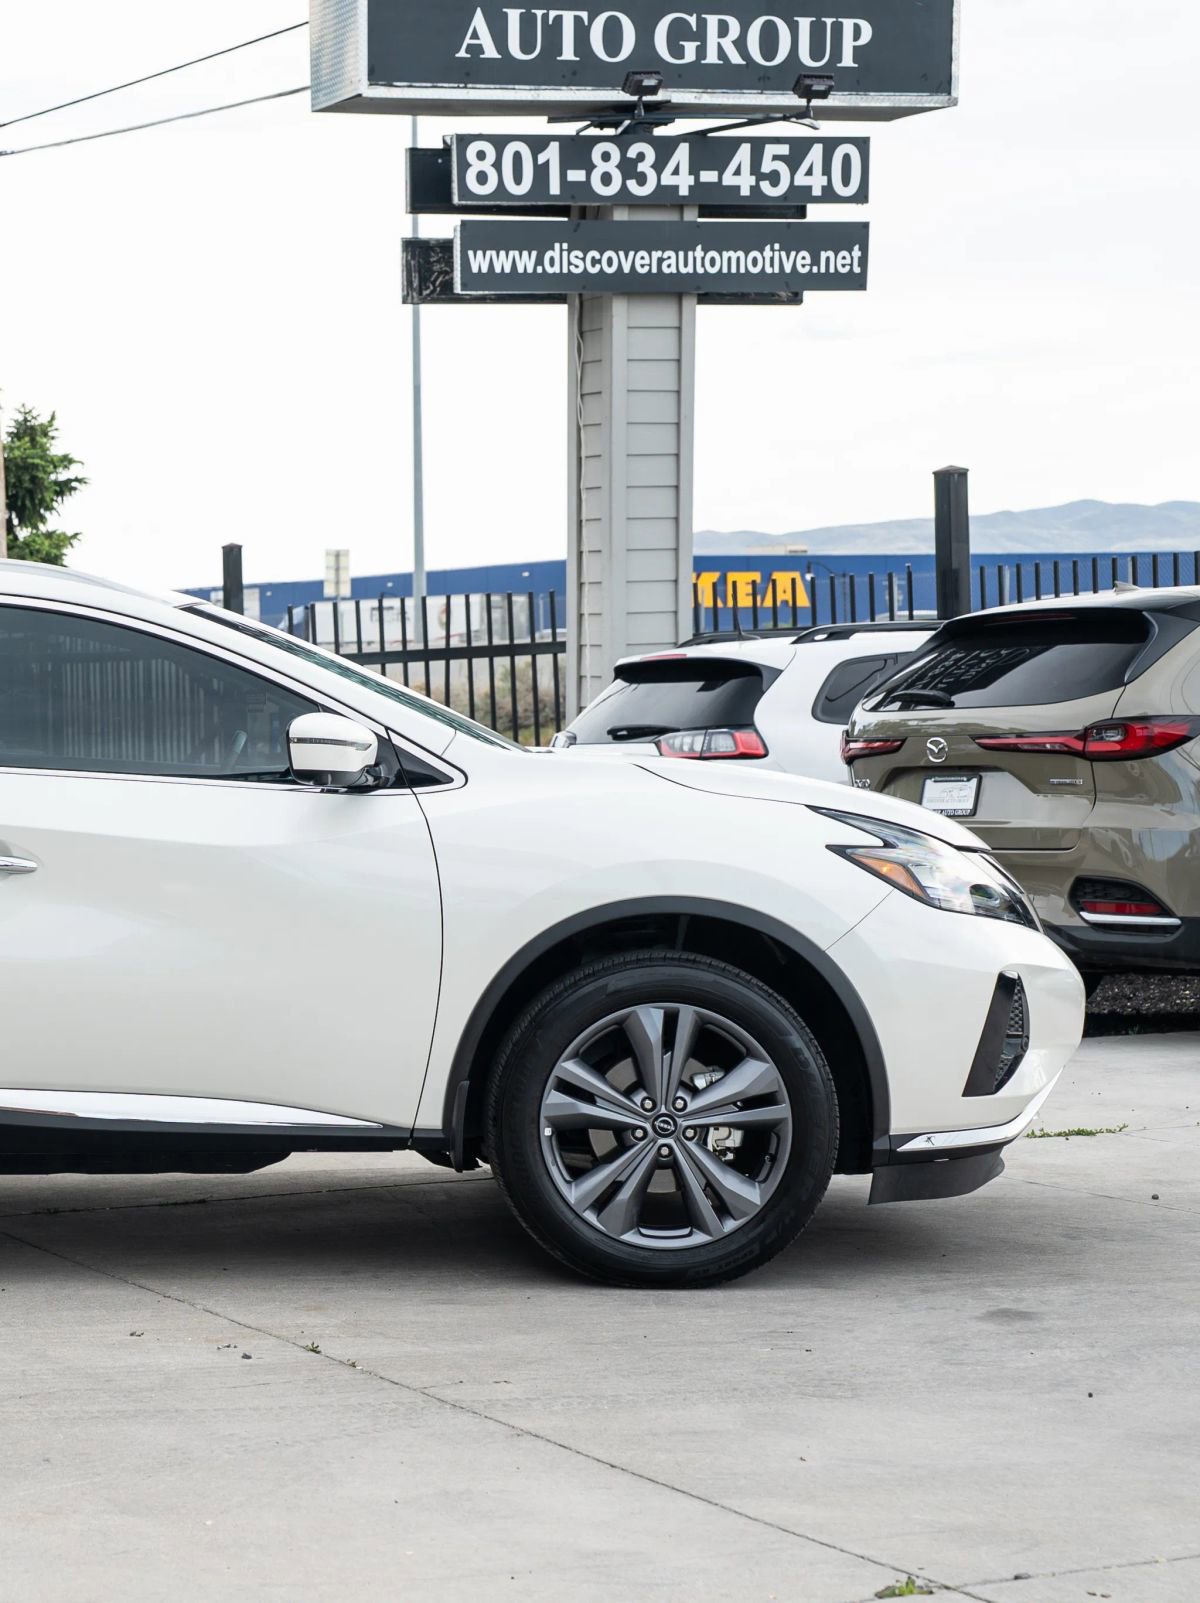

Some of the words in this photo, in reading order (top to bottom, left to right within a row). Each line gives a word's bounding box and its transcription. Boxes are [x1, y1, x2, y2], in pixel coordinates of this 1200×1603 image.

[454, 6, 636, 63] AUTO
[653, 12, 873, 68] GROUP
[465, 140, 862, 197] 801-834-4540
[467, 242, 862, 274] www.discoverautomotive.net
[692, 571, 810, 607] KEA
